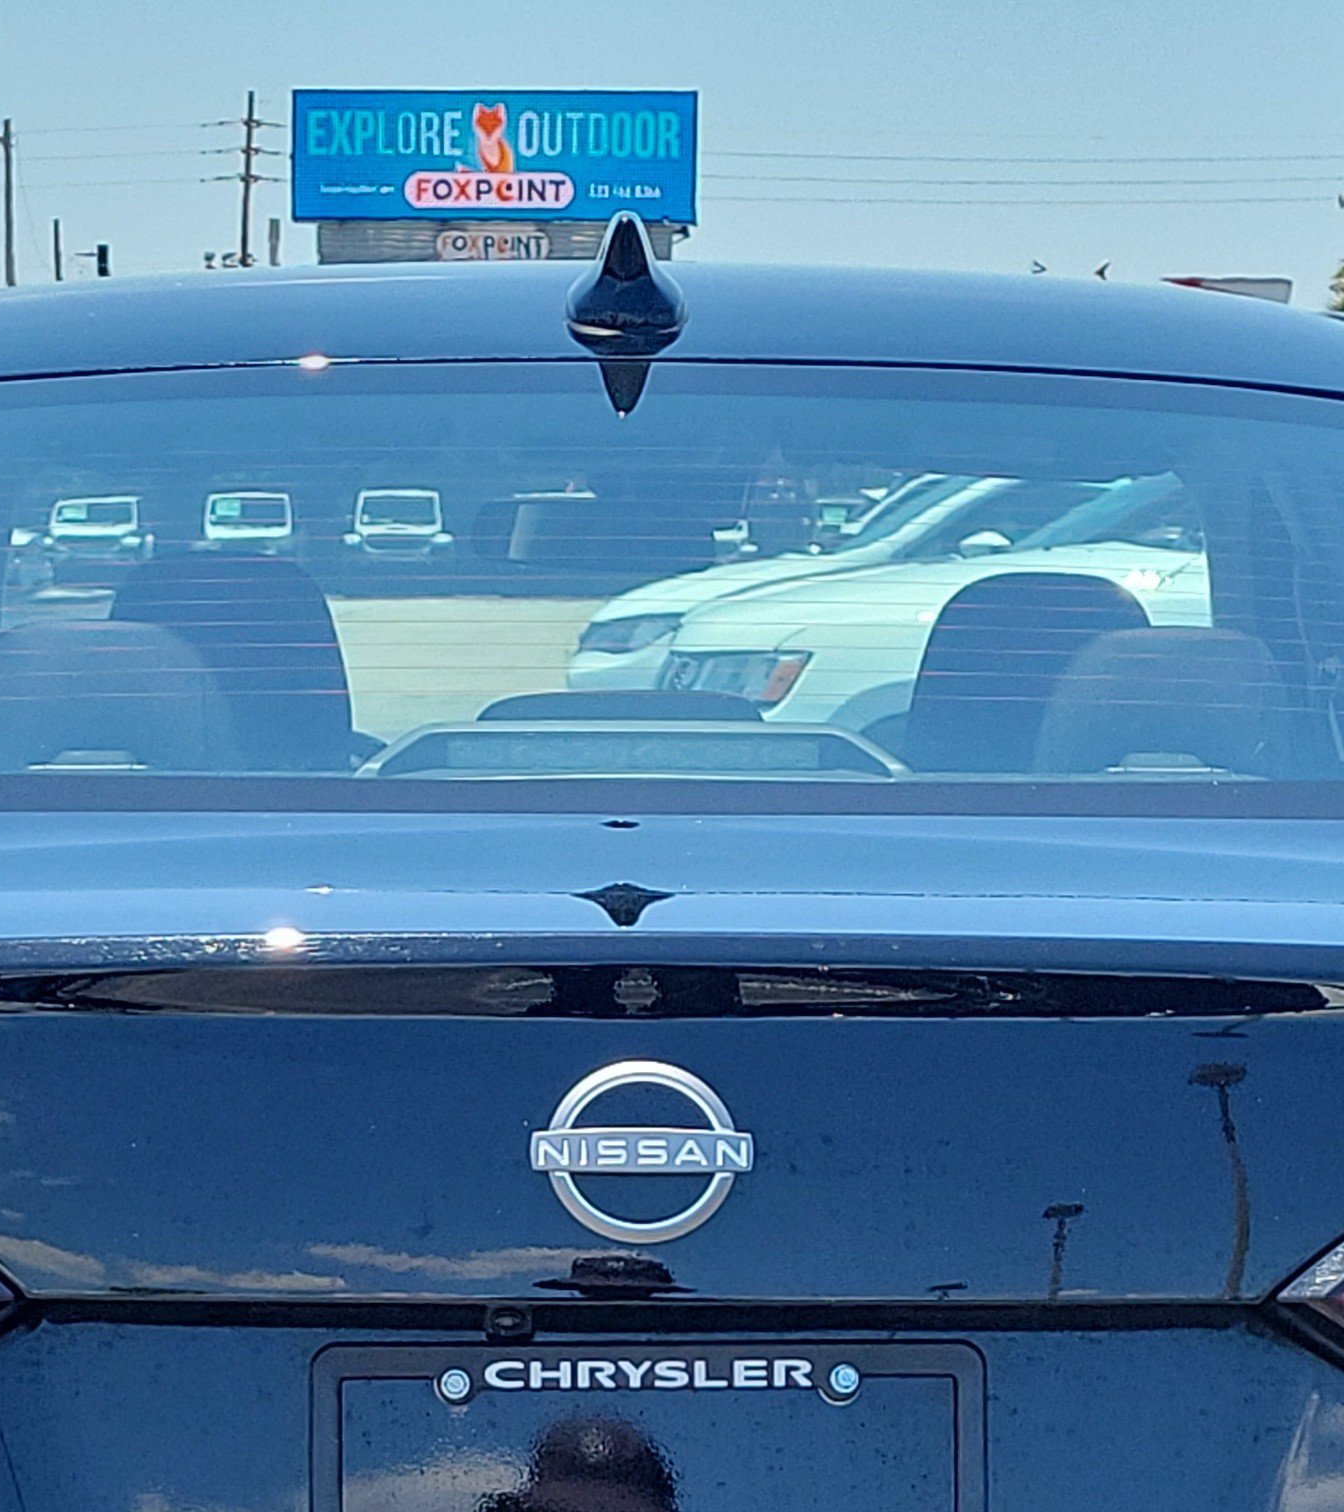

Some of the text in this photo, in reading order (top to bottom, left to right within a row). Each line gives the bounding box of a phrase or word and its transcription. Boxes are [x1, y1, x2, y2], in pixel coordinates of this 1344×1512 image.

[308, 110, 680, 158] EXPLORE OUTDOOR
[416, 179, 566, 201] FOXPOINT
[538, 1139, 748, 1167] NISSAN
[484, 1359, 813, 1389] CHRYSLER
